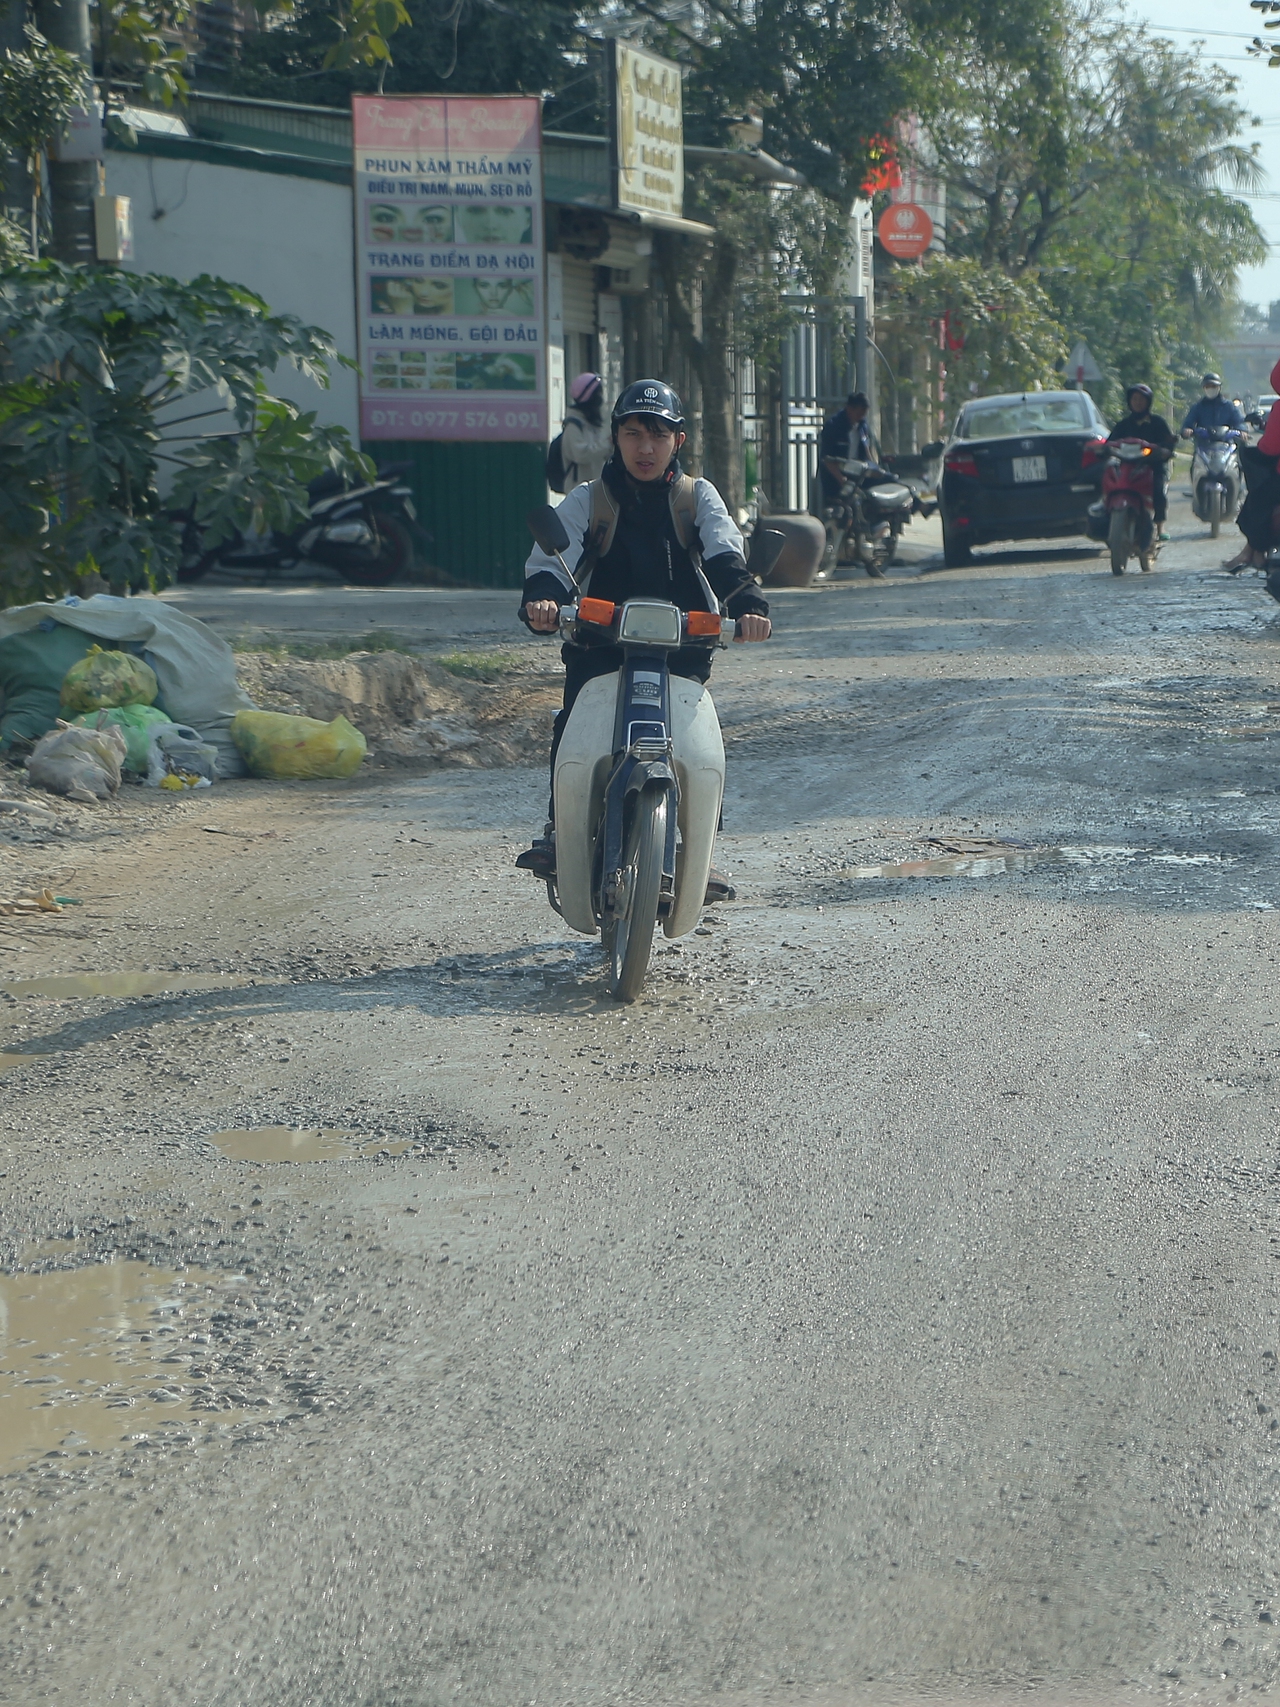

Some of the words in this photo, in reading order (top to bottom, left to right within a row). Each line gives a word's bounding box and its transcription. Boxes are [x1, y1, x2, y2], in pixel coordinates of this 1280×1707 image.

[365, 158, 412, 173] PHUN
[508, 158, 533, 175] MỸ
[367, 252, 425, 269] TRANG
[369, 324, 404, 341] LÀM
[411, 411, 459, 427] 0977
[465, 411, 499, 428] 576
[504, 411, 540, 429] 091
